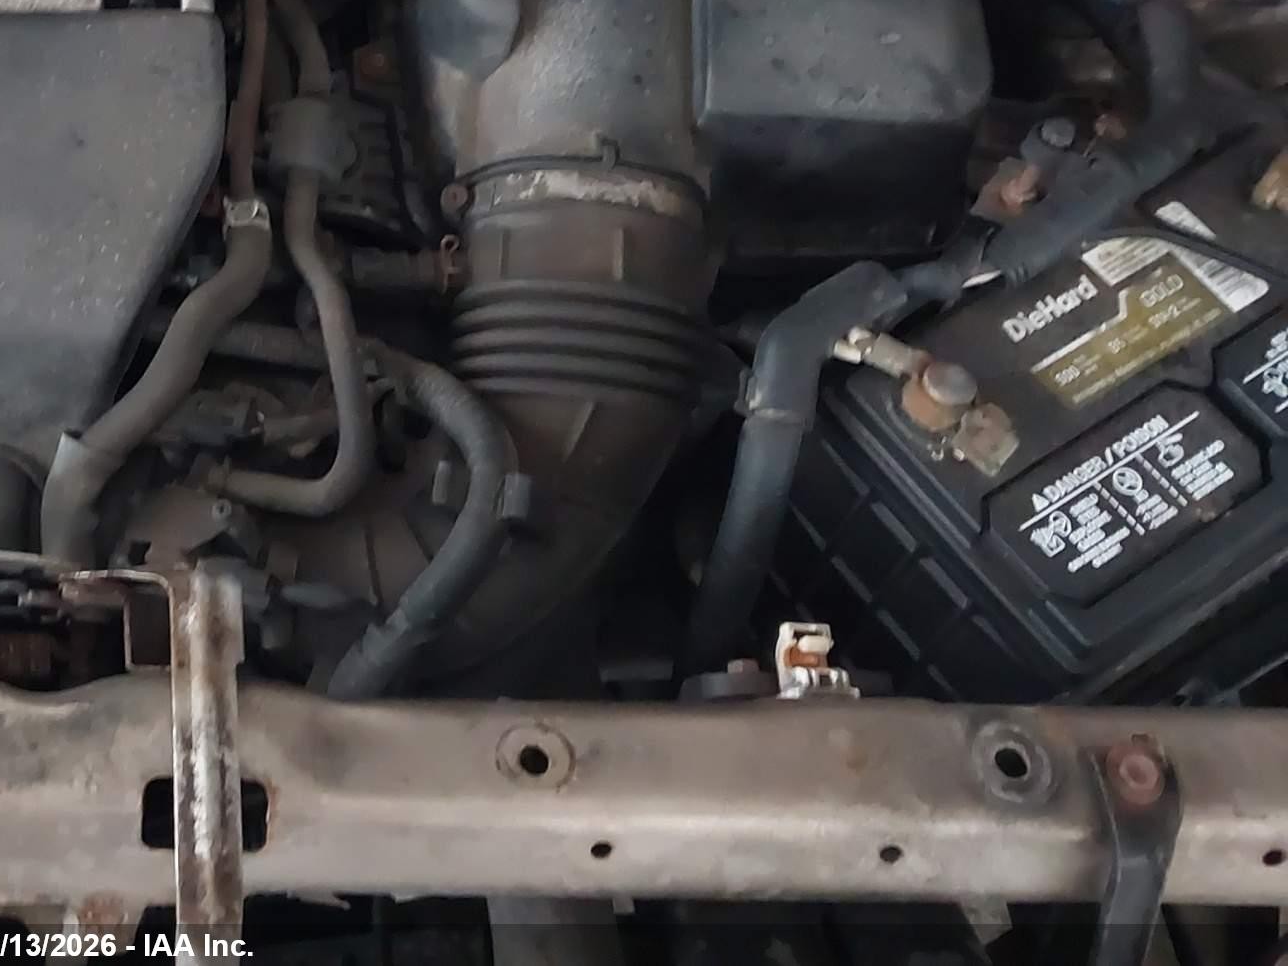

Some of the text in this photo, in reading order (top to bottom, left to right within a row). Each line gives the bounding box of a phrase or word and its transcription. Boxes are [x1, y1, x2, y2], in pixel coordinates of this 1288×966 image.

[1002, 274, 1098, 343] DieHard
[1139, 274, 1184, 308] GOLD
[1043, 455, 1107, 503] DANGER
[1112, 415, 1169, 458] POISON
